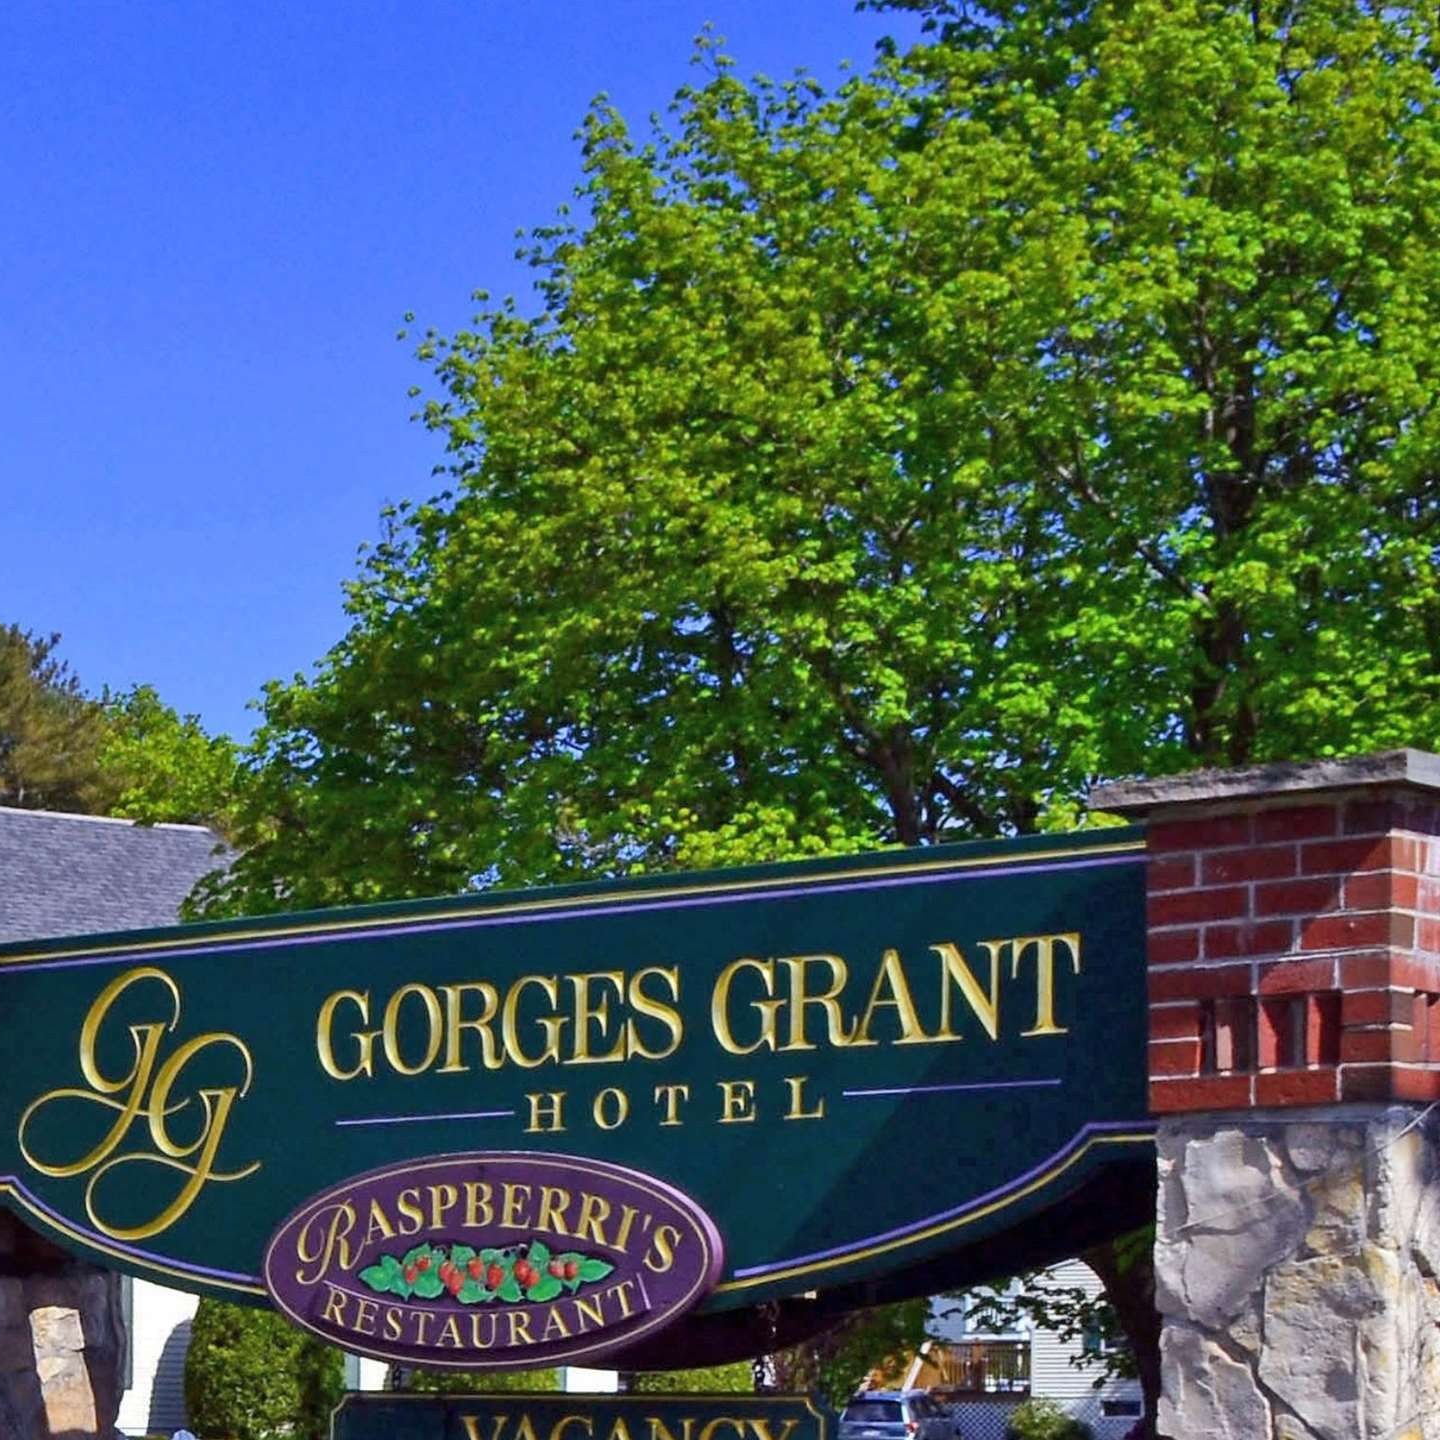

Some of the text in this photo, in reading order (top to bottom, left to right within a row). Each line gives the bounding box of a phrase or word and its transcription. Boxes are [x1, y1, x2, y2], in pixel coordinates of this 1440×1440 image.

[316, 932, 1081, 1081] GORGES GRANT
[523, 1075, 825, 1133] HOTEL
[296, 1182, 684, 1285] RASPBERRI'S
[323, 1280, 636, 1349] RESTAURANT
